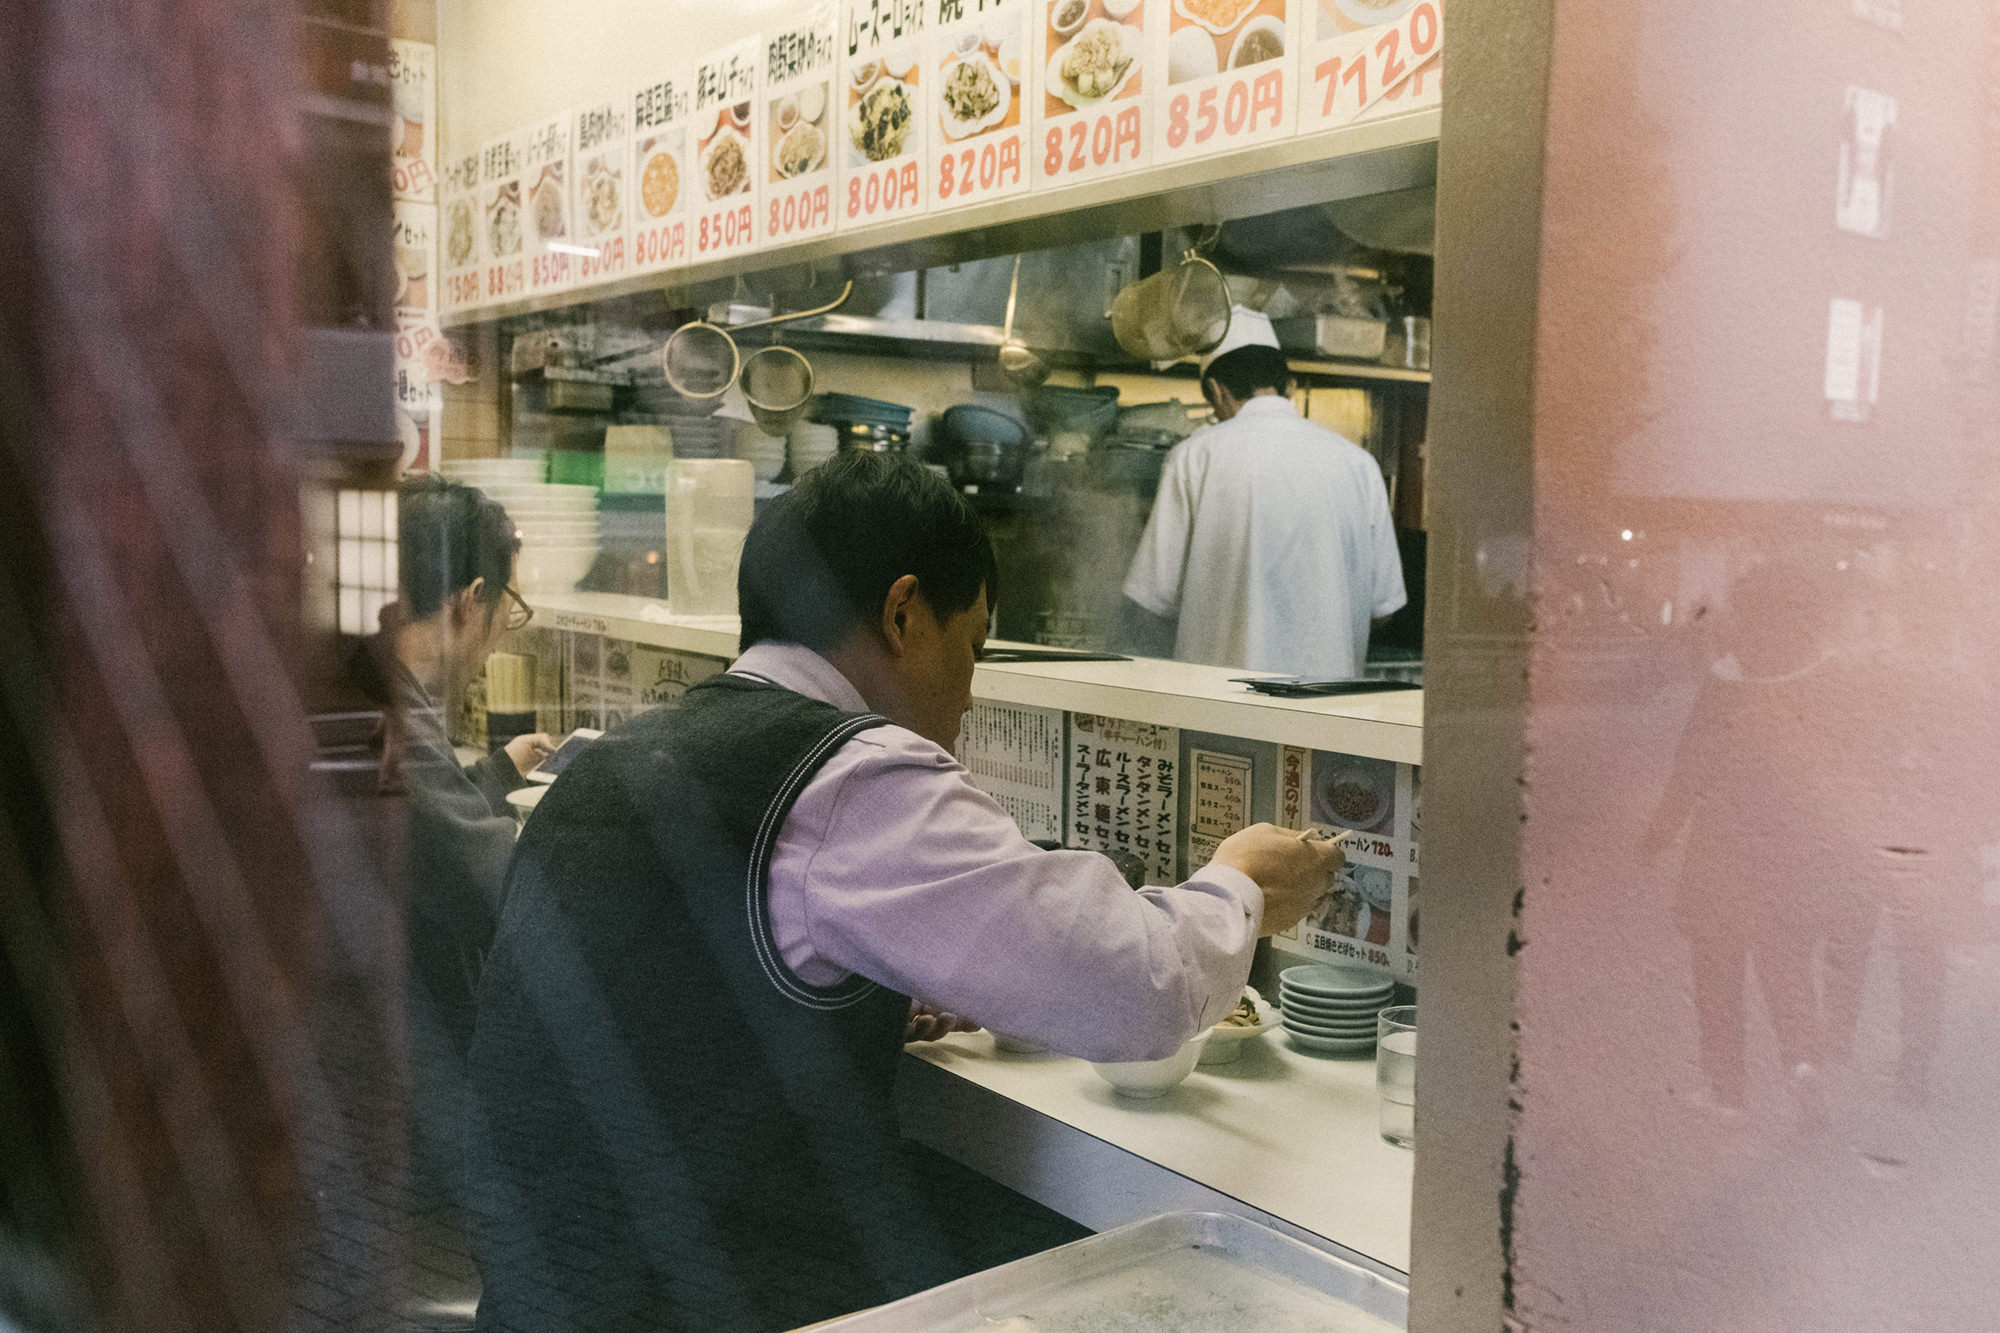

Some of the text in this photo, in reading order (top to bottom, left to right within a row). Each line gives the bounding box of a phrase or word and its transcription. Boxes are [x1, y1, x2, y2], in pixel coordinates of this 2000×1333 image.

[1044, 105, 1141, 176] 820円
[1166, 68, 1283, 149] 850円
[847, 160, 918, 218] 800円
[938, 135, 1020, 199] 820円
[636, 221, 684, 266] 800円
[699, 204, 752, 252] 850円
[769, 184, 829, 237] 800円
[1075, 744, 1090, 847] スーラータンメンセッ
[1094, 748, 1112, 850] 広東麺セッ
[1115, 752, 1131, 852] ルースラーメンセッ
[1135, 756, 1151, 871] タンタンメンセッ
[1155, 759, 1174, 879] みそラーメンセット
